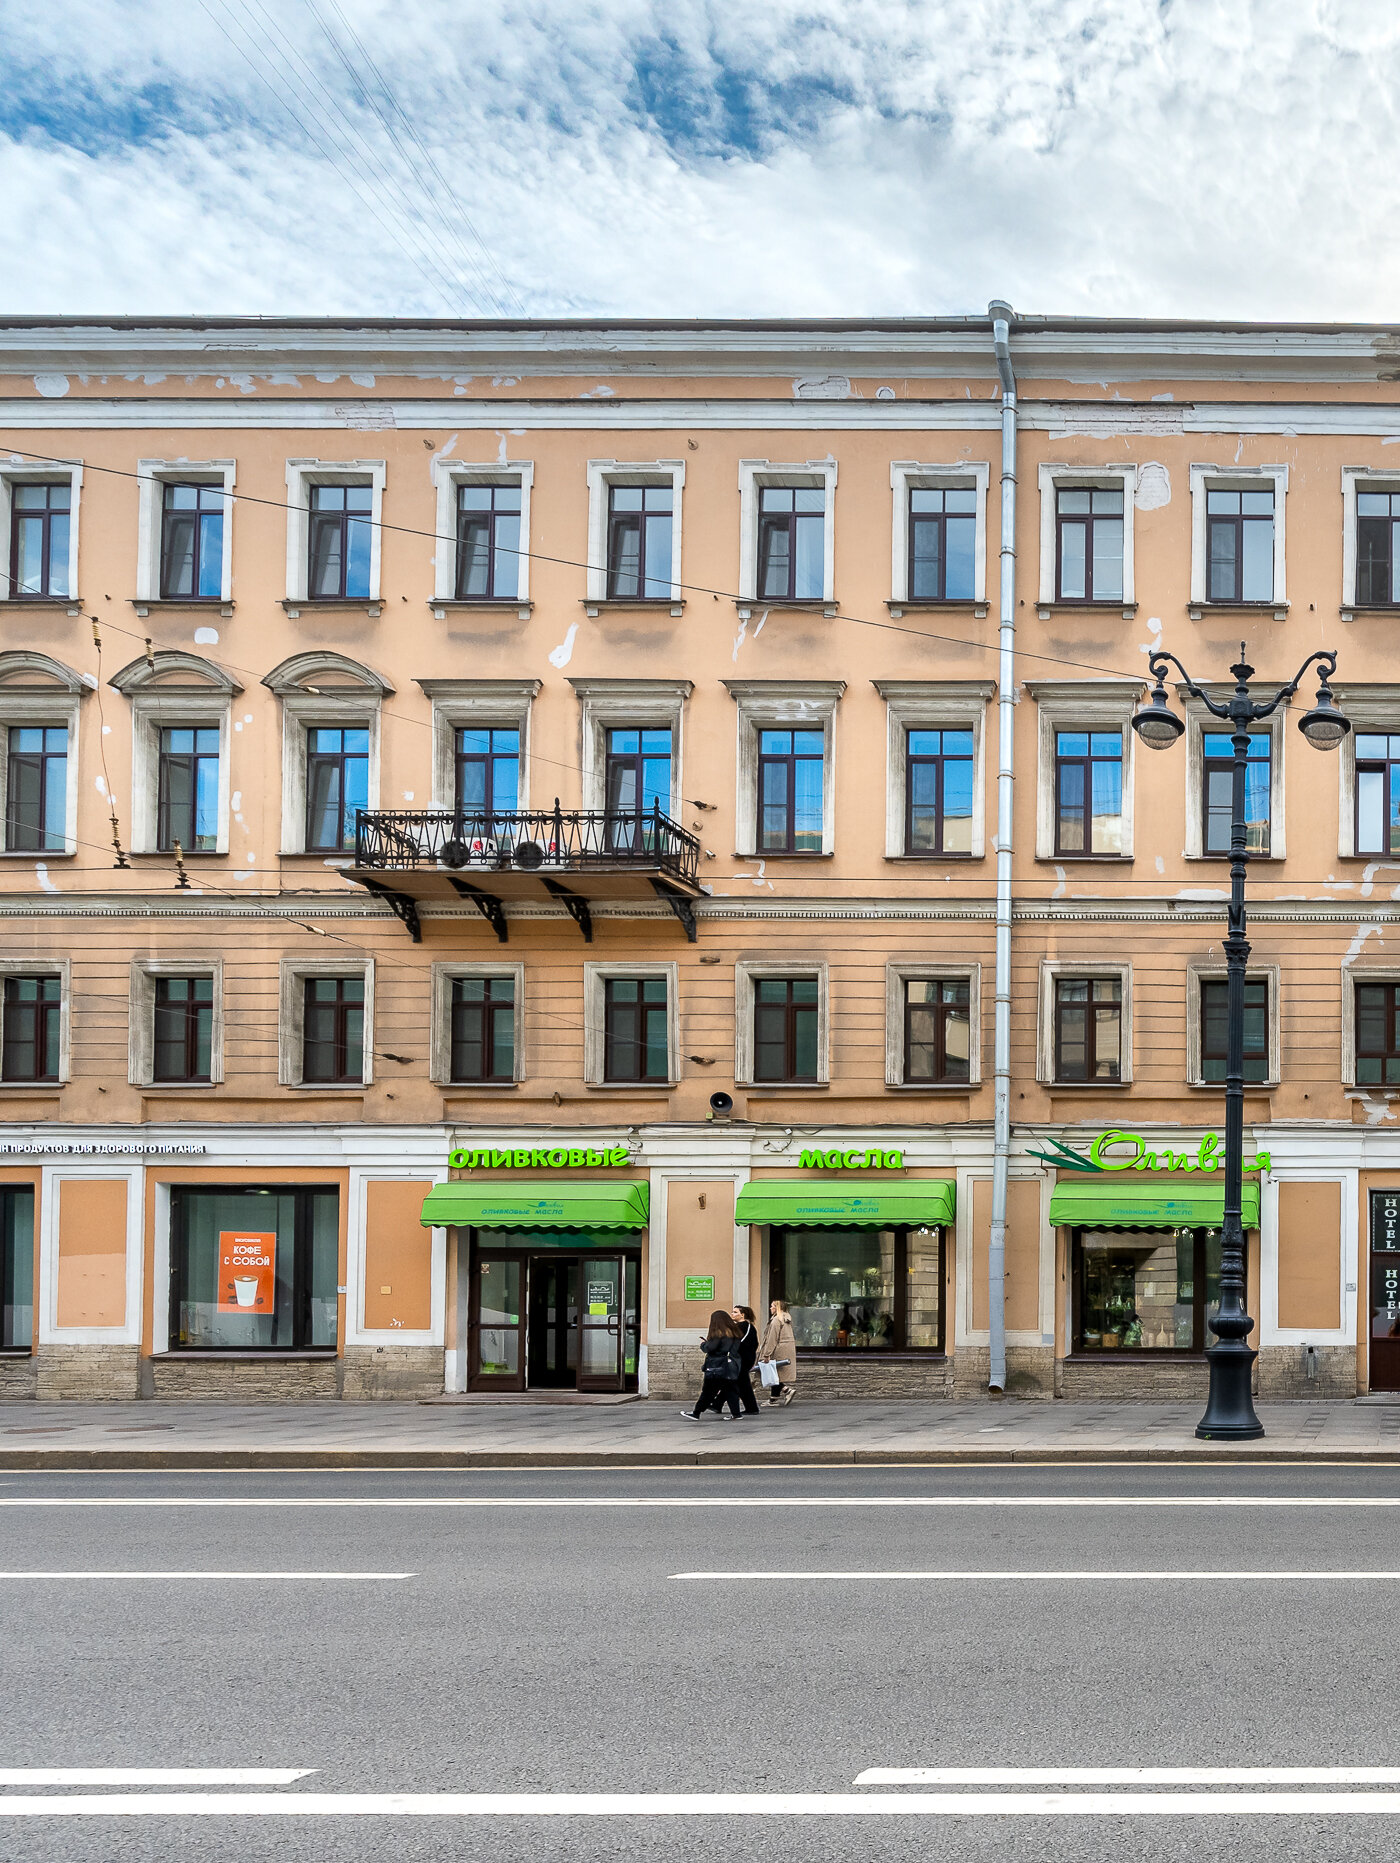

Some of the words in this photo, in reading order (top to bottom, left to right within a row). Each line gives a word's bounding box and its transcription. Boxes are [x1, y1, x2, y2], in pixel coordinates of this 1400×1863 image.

[11, 1144, 70, 1154] ПРОДУКТОВ
[72, 1144, 93, 1154] ДЛЯ
[95, 1144, 157, 1153] ЗДОРОВОГО
[158, 1145, 205, 1153] ПИТАНИЯ
[798, 1148, 905, 1169] масла
[1090, 1129, 1271, 1173] Оливя
[1384, 1198, 1398, 1249] HOTEL
[233, 1245, 262, 1255] КОФЕ
[223, 1256, 230, 1265] С
[232, 1256, 270, 1266] СОБОЙ
[1385, 1269, 1398, 1320] HOTEL
